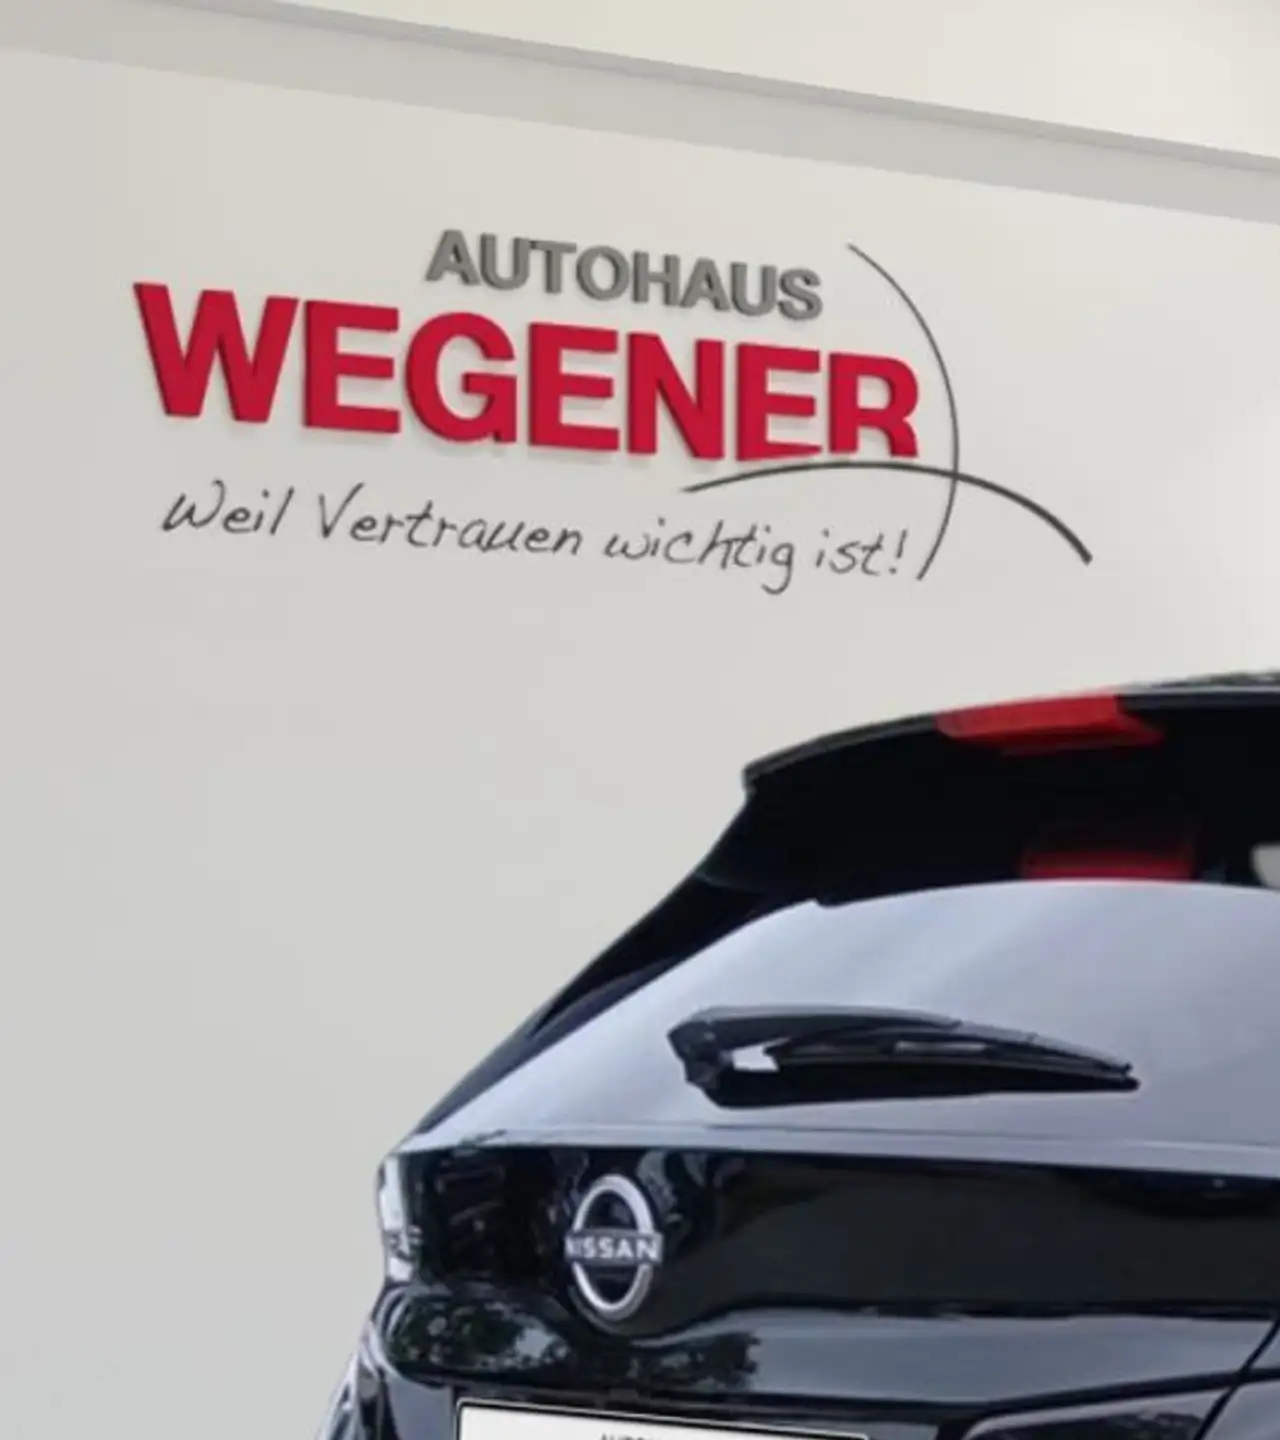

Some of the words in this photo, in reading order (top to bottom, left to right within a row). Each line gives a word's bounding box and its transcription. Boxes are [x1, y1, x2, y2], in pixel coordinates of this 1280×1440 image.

[426, 229, 823, 322] AUTOHAUS
[132, 282, 921, 463] WEGENER
[162, 479, 294, 538] Weil
[316, 481, 583, 558] Vertrauen
[602, 515, 796, 595] wichtig
[812, 529, 911, 579] ist!
